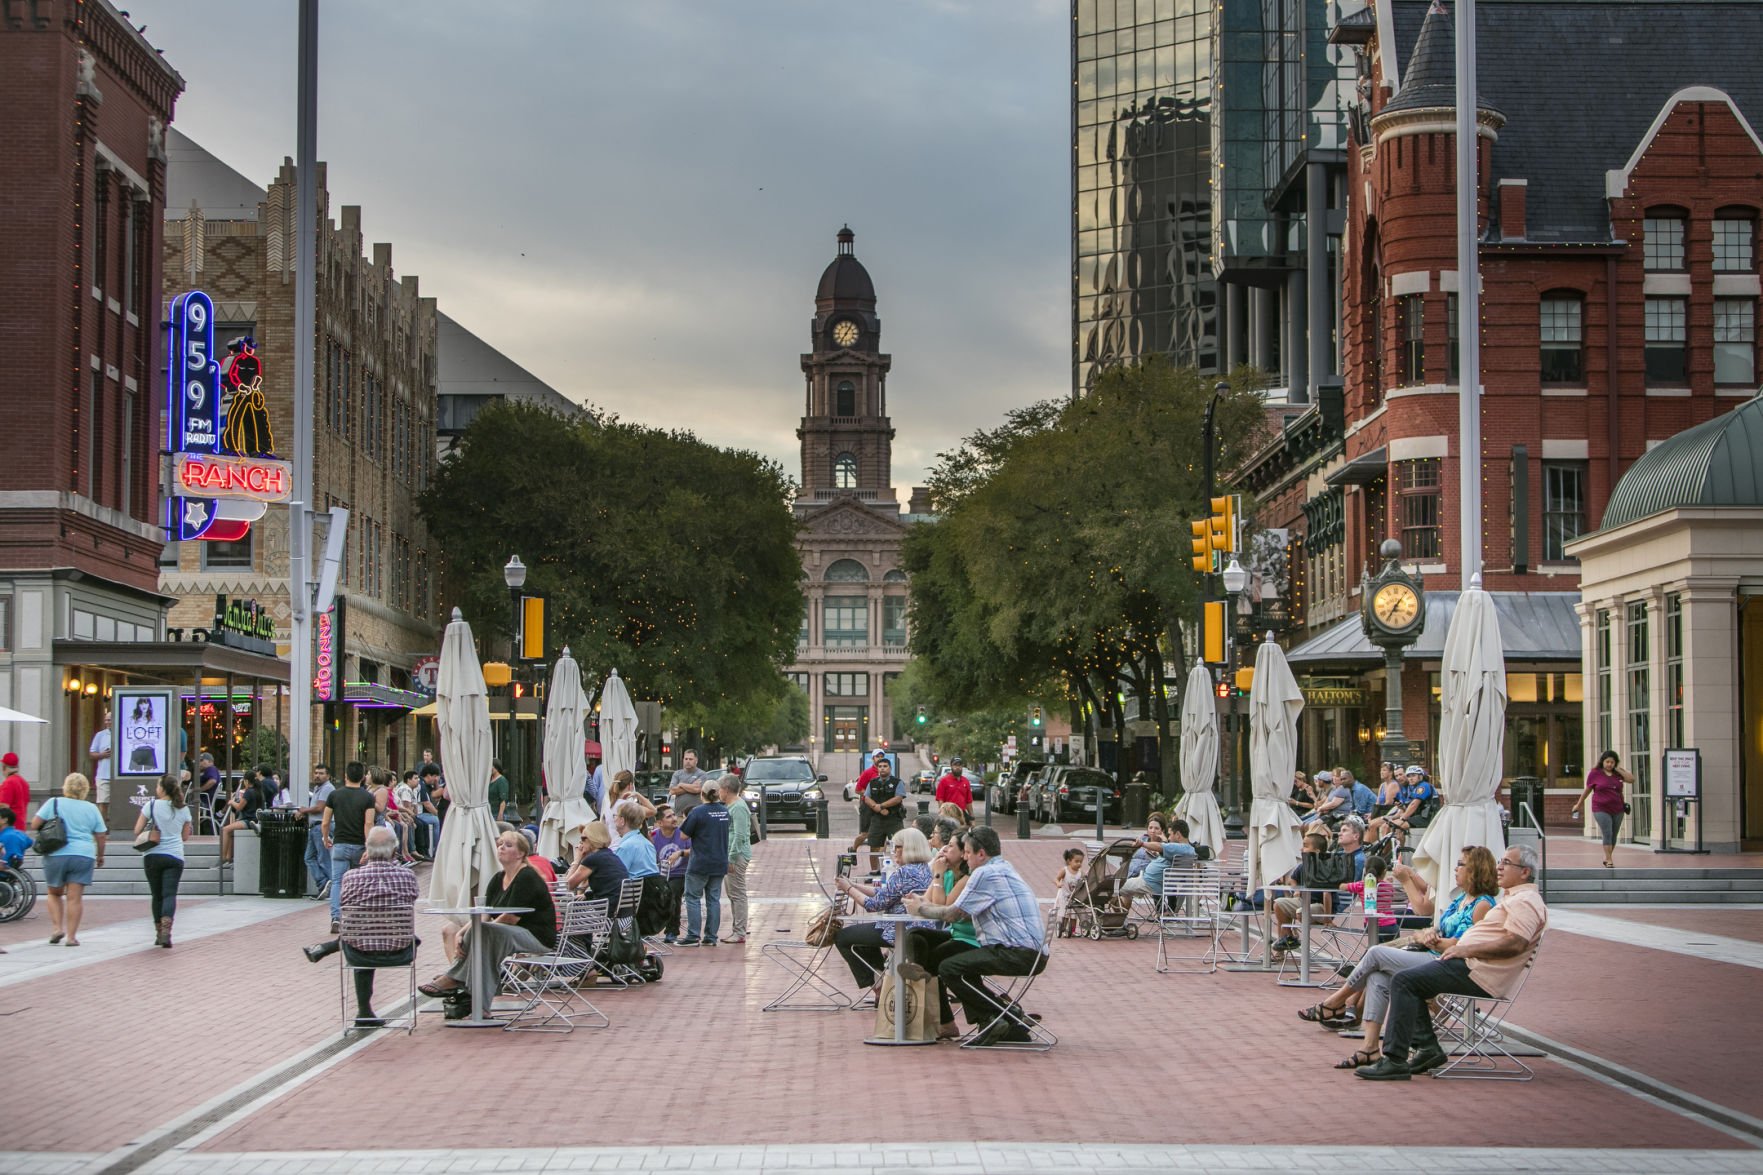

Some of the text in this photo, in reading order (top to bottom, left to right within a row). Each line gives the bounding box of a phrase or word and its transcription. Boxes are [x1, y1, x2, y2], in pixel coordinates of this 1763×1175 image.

[188, 417, 212, 433] FM
[186, 432, 216, 444] RADIO
[182, 461, 282, 494] RANCH
[1308, 690, 1361, 700] HALTOM'S
[126, 726, 162, 740] LOFT
